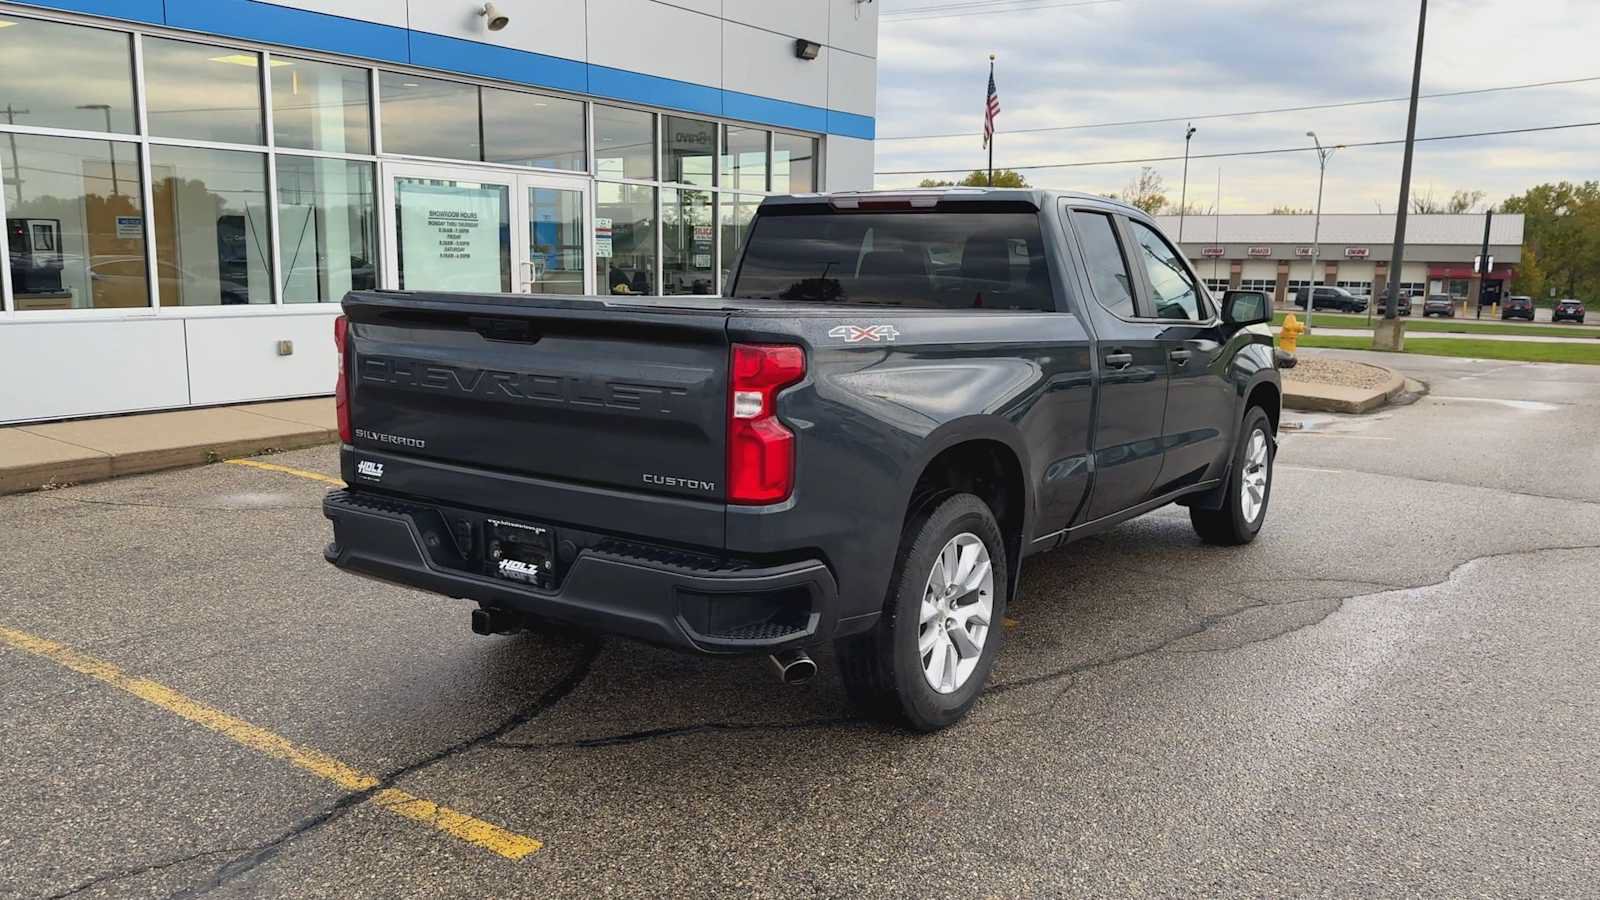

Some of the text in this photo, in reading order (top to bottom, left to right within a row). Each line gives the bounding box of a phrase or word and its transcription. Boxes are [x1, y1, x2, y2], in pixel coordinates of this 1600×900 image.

[362, 355, 689, 414] CHEVROLET
[355, 428, 425, 448] SILVERADO
[358, 460, 384, 476] HOLZ
[642, 474, 715, 491] CUSTOM
[499, 559, 538, 575] HOLZ
